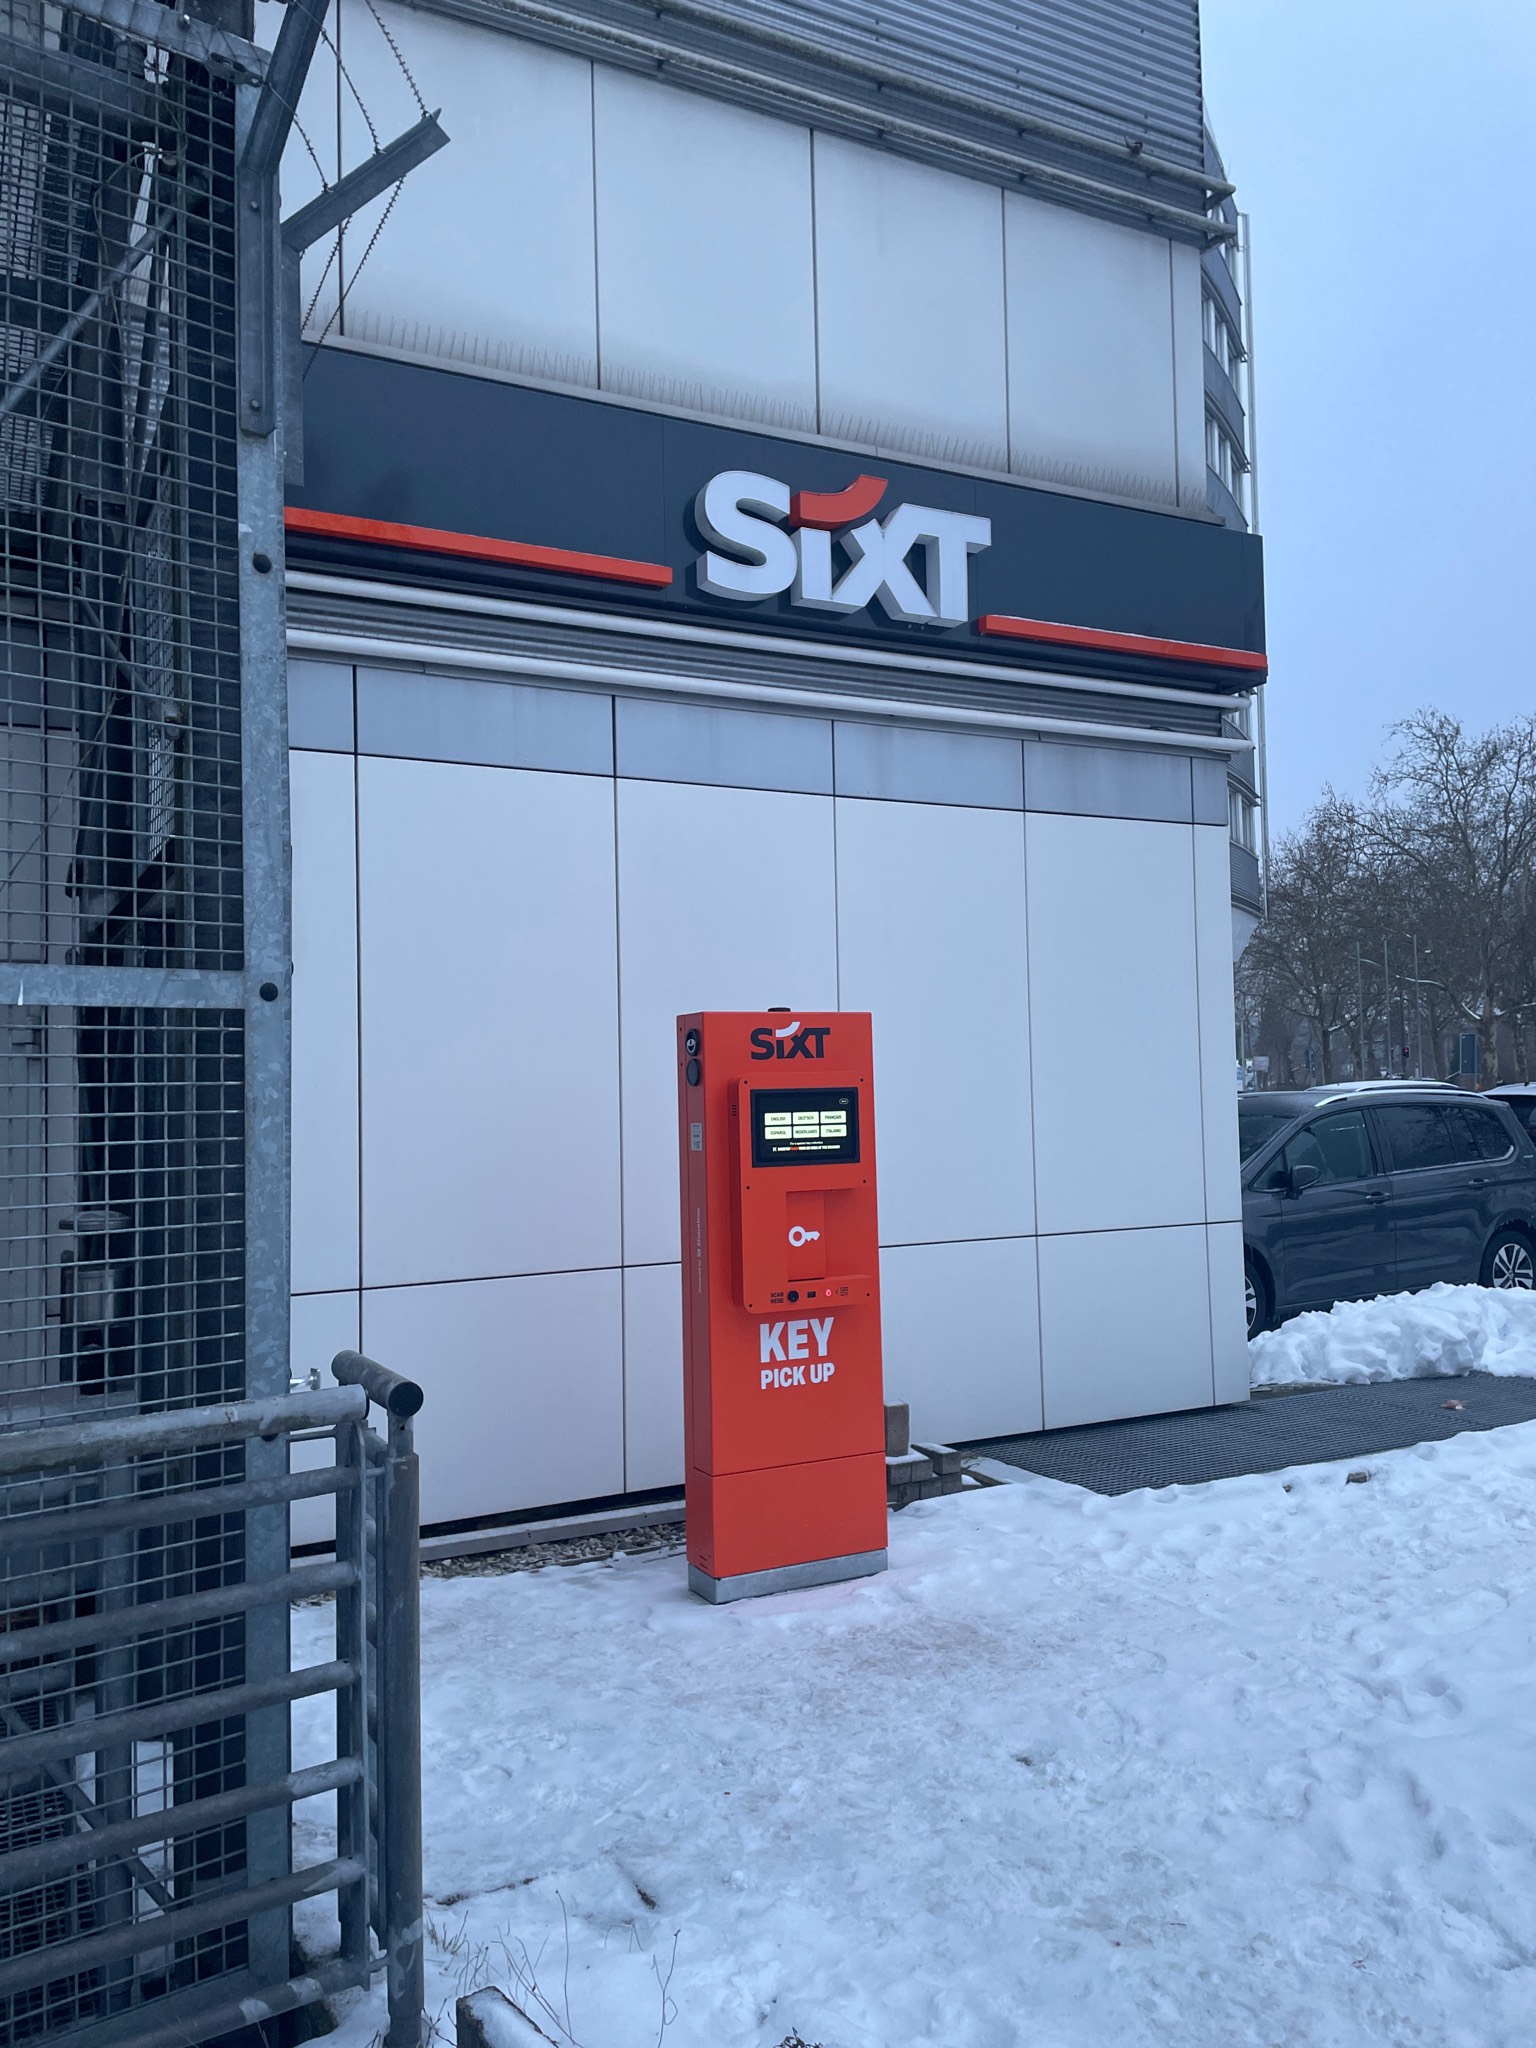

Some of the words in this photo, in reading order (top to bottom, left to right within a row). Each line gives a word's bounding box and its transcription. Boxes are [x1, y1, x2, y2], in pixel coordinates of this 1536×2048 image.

[760, 1316, 835, 1363] KEY
[761, 1365, 806, 1390] PICK
[810, 1362, 835, 1384] UP
